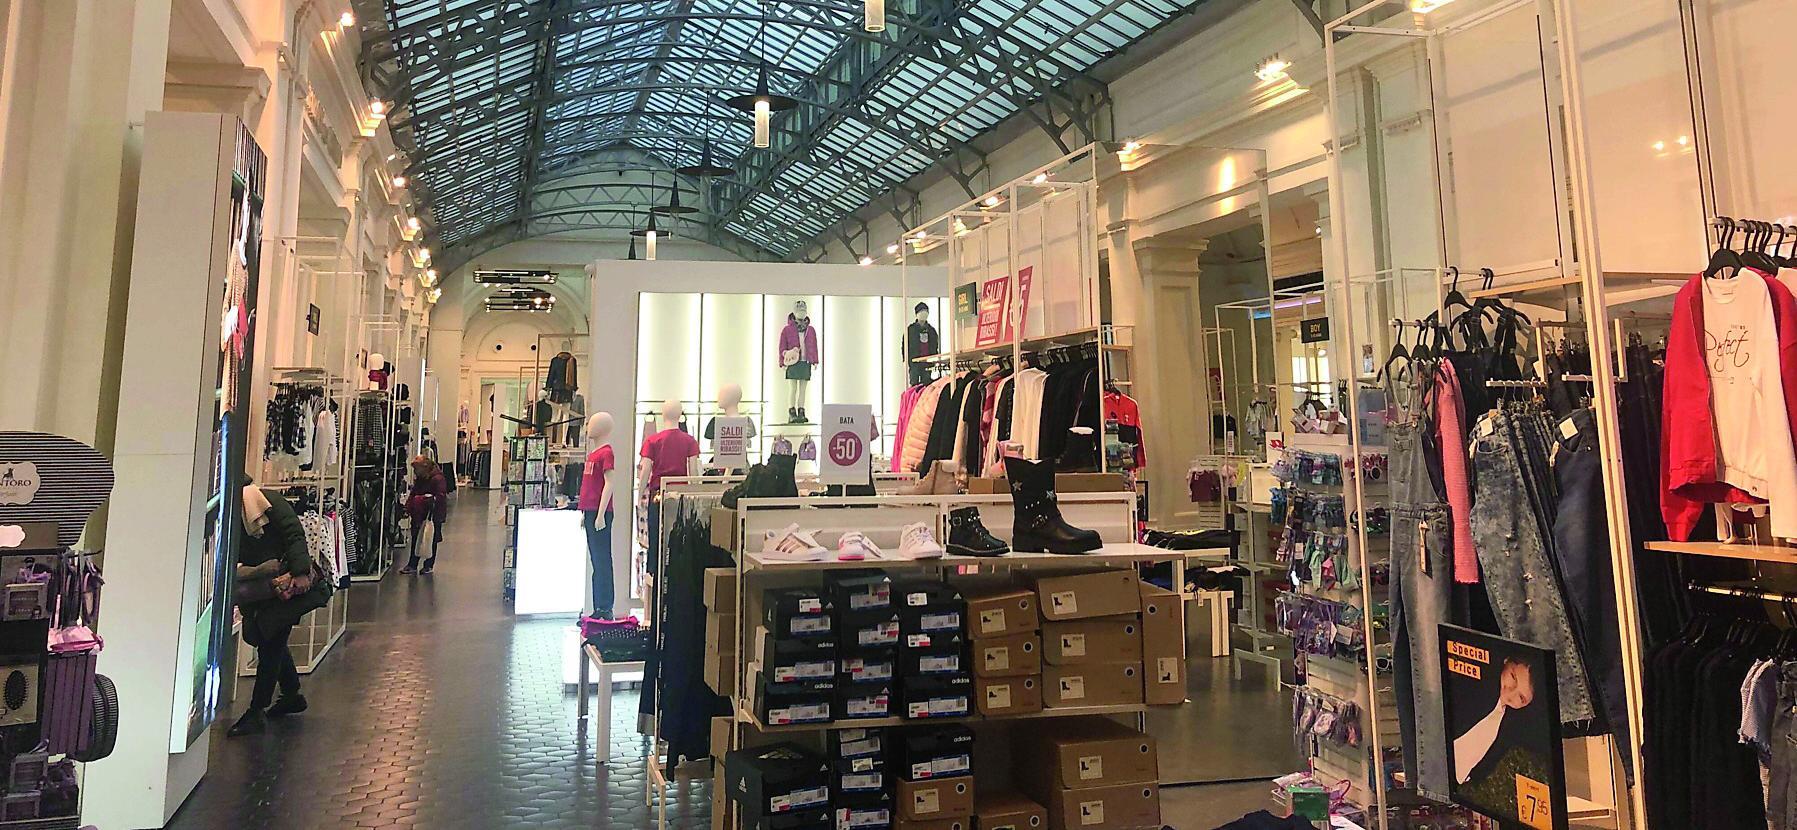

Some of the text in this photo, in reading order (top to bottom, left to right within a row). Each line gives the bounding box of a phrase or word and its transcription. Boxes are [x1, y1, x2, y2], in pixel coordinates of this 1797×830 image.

[1310, 323, 1321, 333] BOY
[839, 416, 854, 424] BATA
[720, 426, 743, 436] SALDI
[1452, 642, 1487, 661] Special
[1453, 659, 1477, 676] Price
